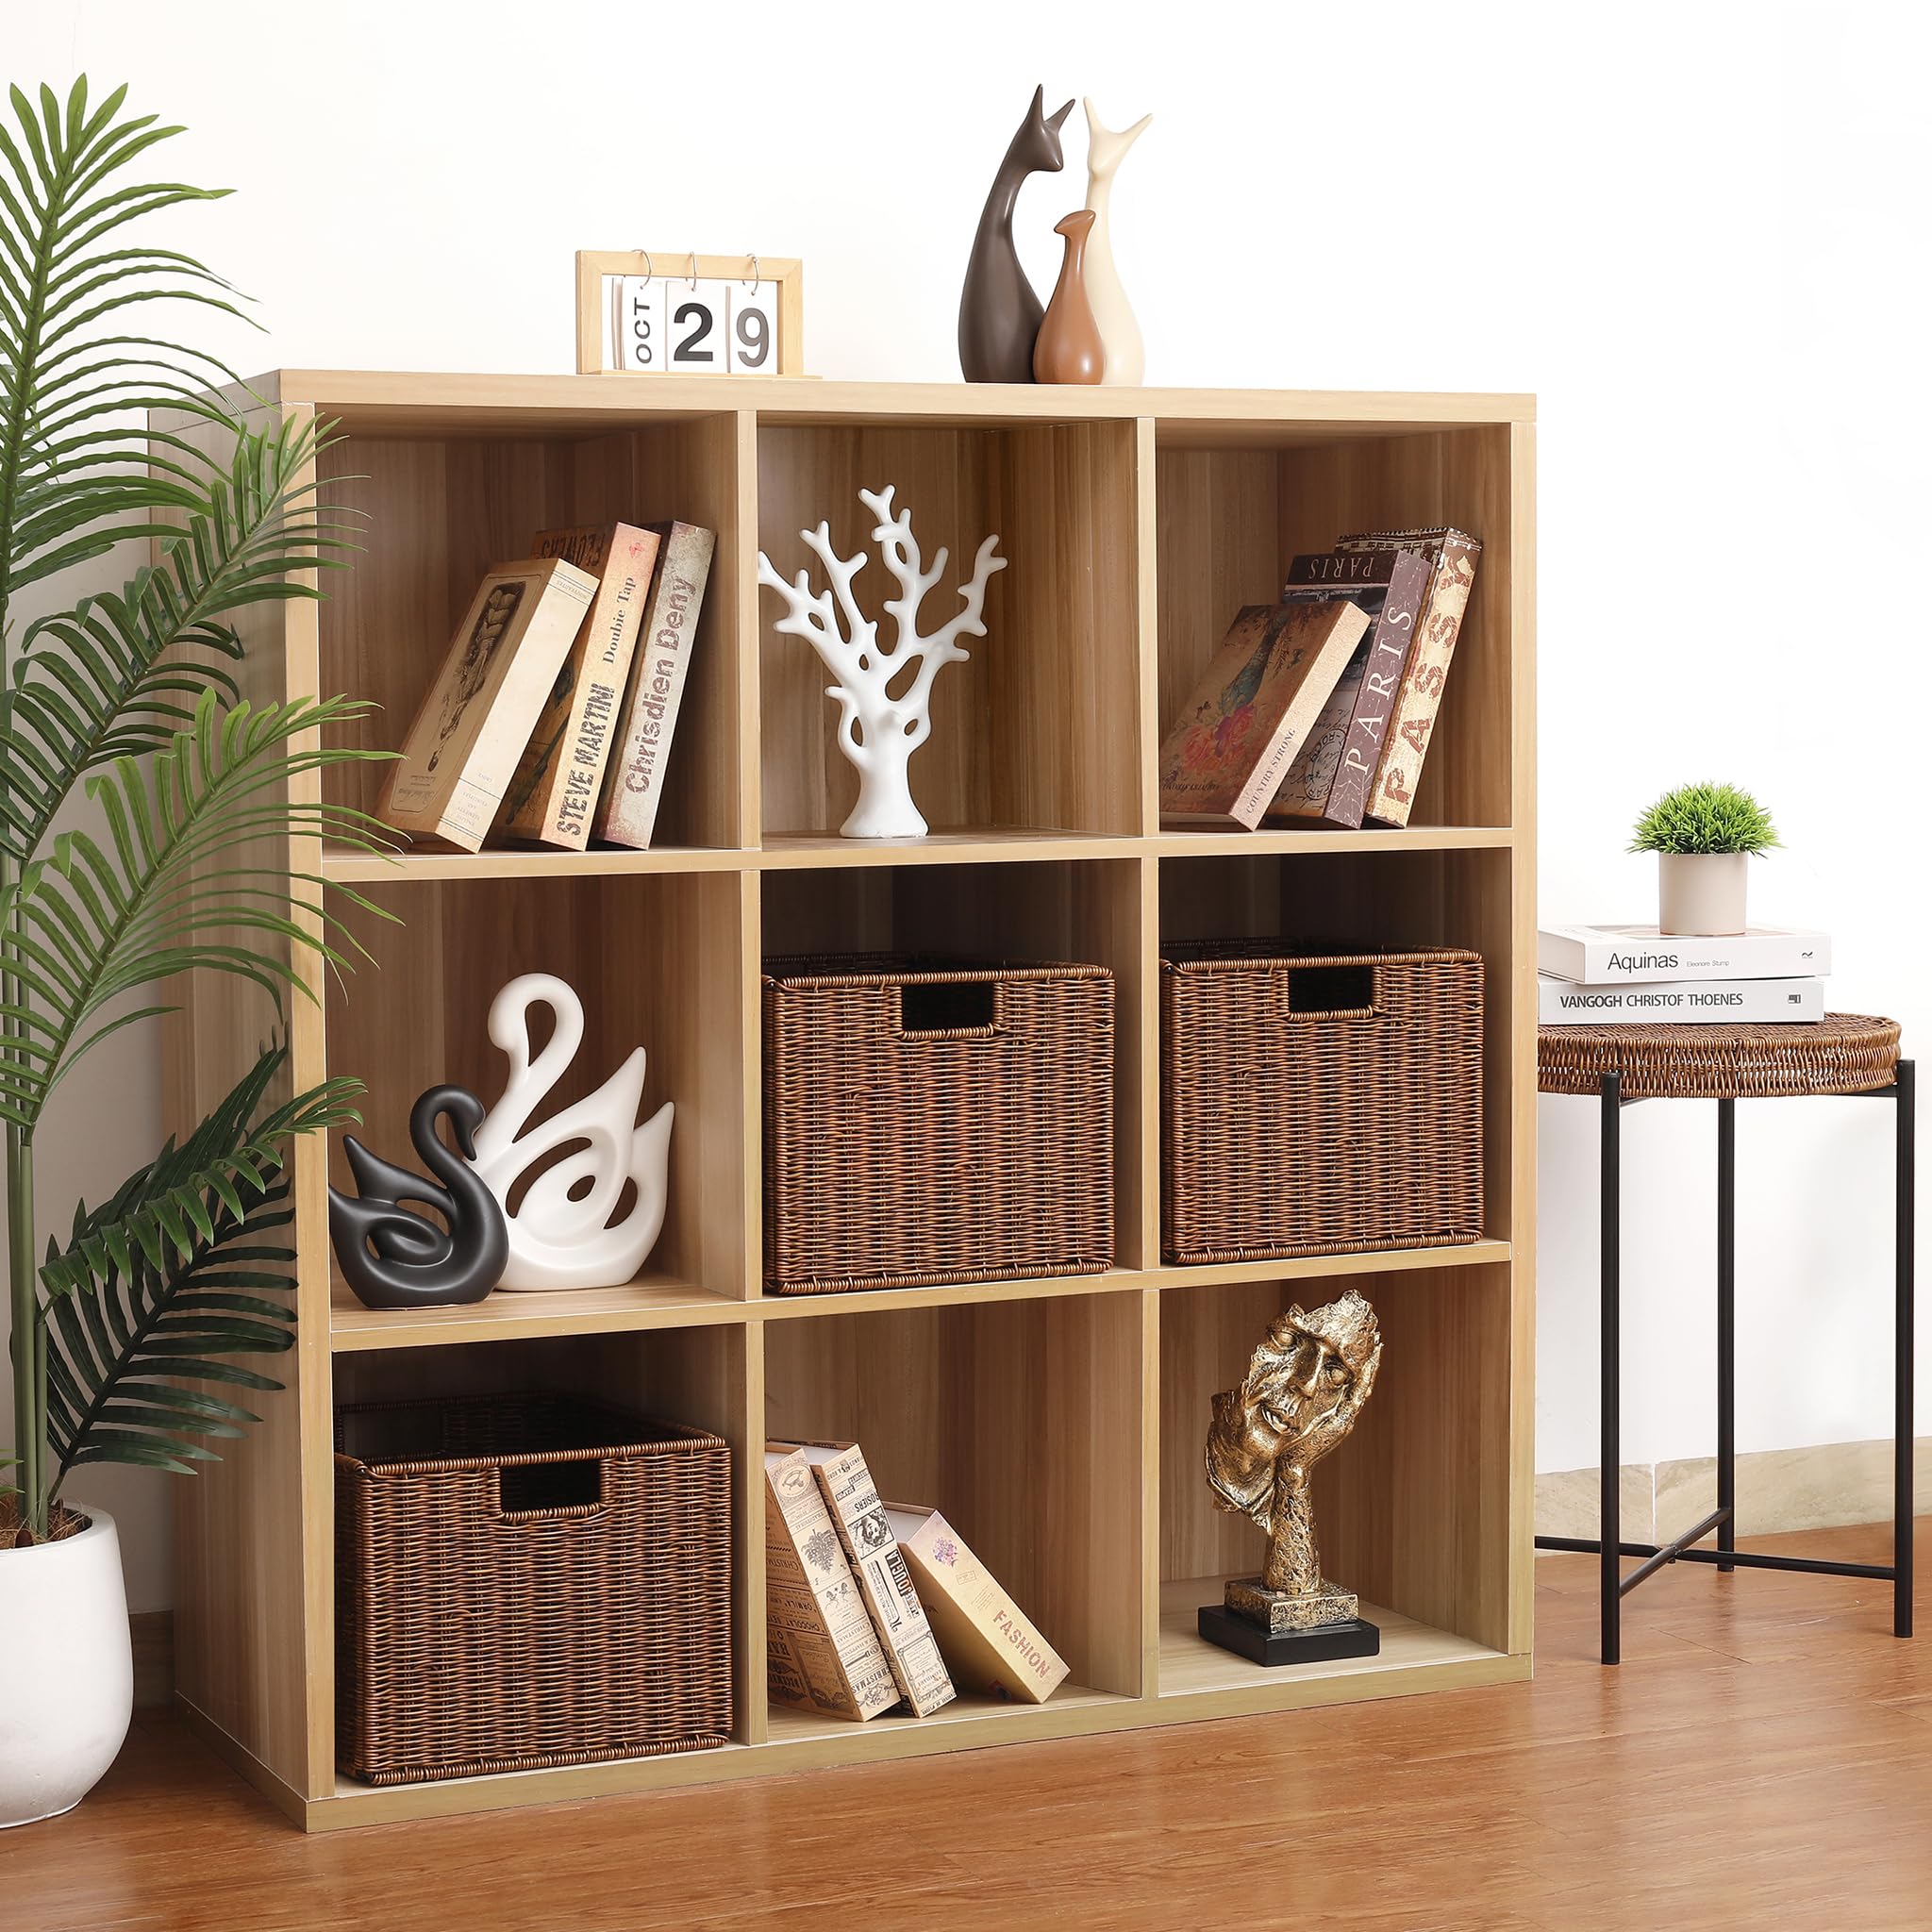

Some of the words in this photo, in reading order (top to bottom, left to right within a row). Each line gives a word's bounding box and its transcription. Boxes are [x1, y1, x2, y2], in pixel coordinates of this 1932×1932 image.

[634, 297, 652, 364] OCT
[1309, 557, 1375, 579] PARIS
[603, 609, 625, 664] Doubie
[617, 576, 636, 605] Tap
[625, 658, 675, 793] Chrisdien
[656, 575, 696, 651] Deny
[1343, 607, 1412, 775] PARIS
[574, 683, 615, 767] MARTINI
[557, 769, 594, 837] STEVE
[1246, 768, 1274, 814] COUNTRY
[1272, 729, 1296, 768] STRONG
[1607, 952, 1678, 974] Aquinas
[1559, 995, 1623, 1008] VANGOGH
[1626, 993, 1684, 1008] CHRISTOF
[1687, 992, 1743, 1007] THOENES
[886, 1549, 913, 1596] JOUGLA
[836, 1622, 871, 1644] CHRISTMAS
[992, 1609, 1051, 1678] FASHION
[852, 1666, 891, 1693] CHRISTMAS
